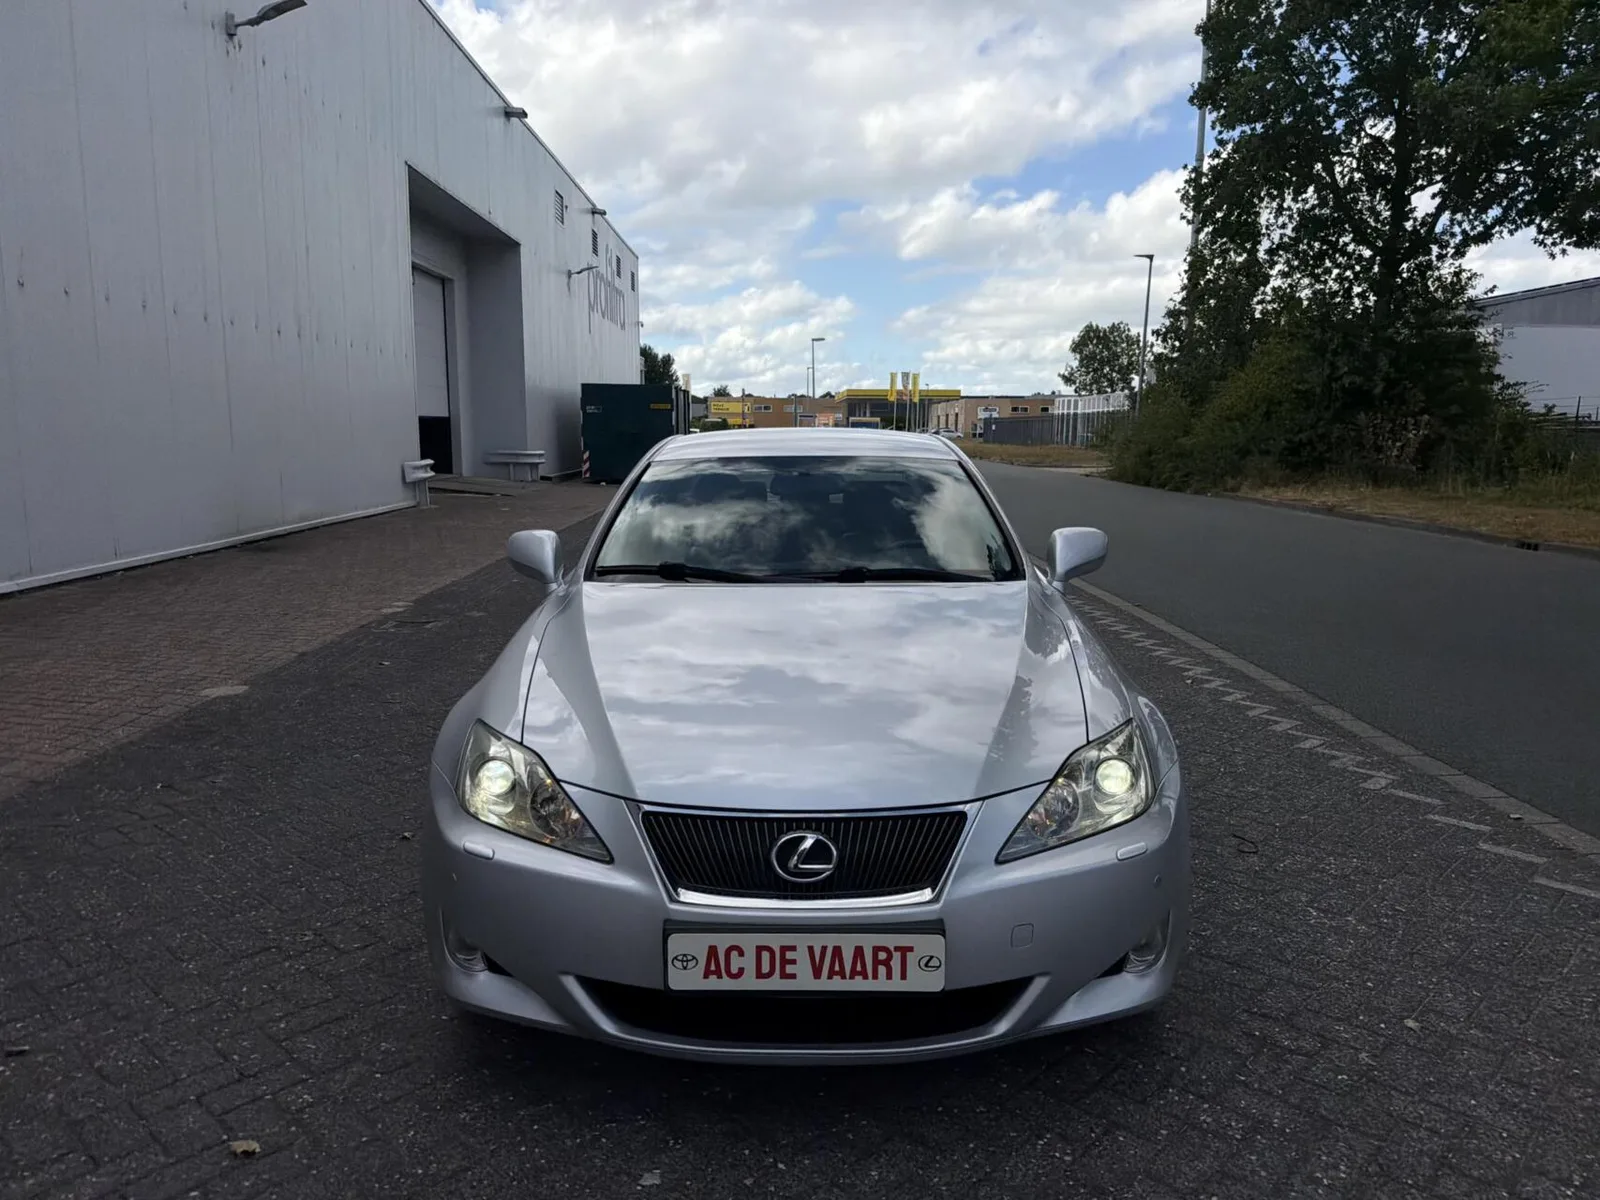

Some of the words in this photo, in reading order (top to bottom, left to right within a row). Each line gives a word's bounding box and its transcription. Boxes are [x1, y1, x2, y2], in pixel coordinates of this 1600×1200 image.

[703, 945, 744, 980] AC
[755, 945, 797, 980] DE
[807, 946, 914, 980] VAART
